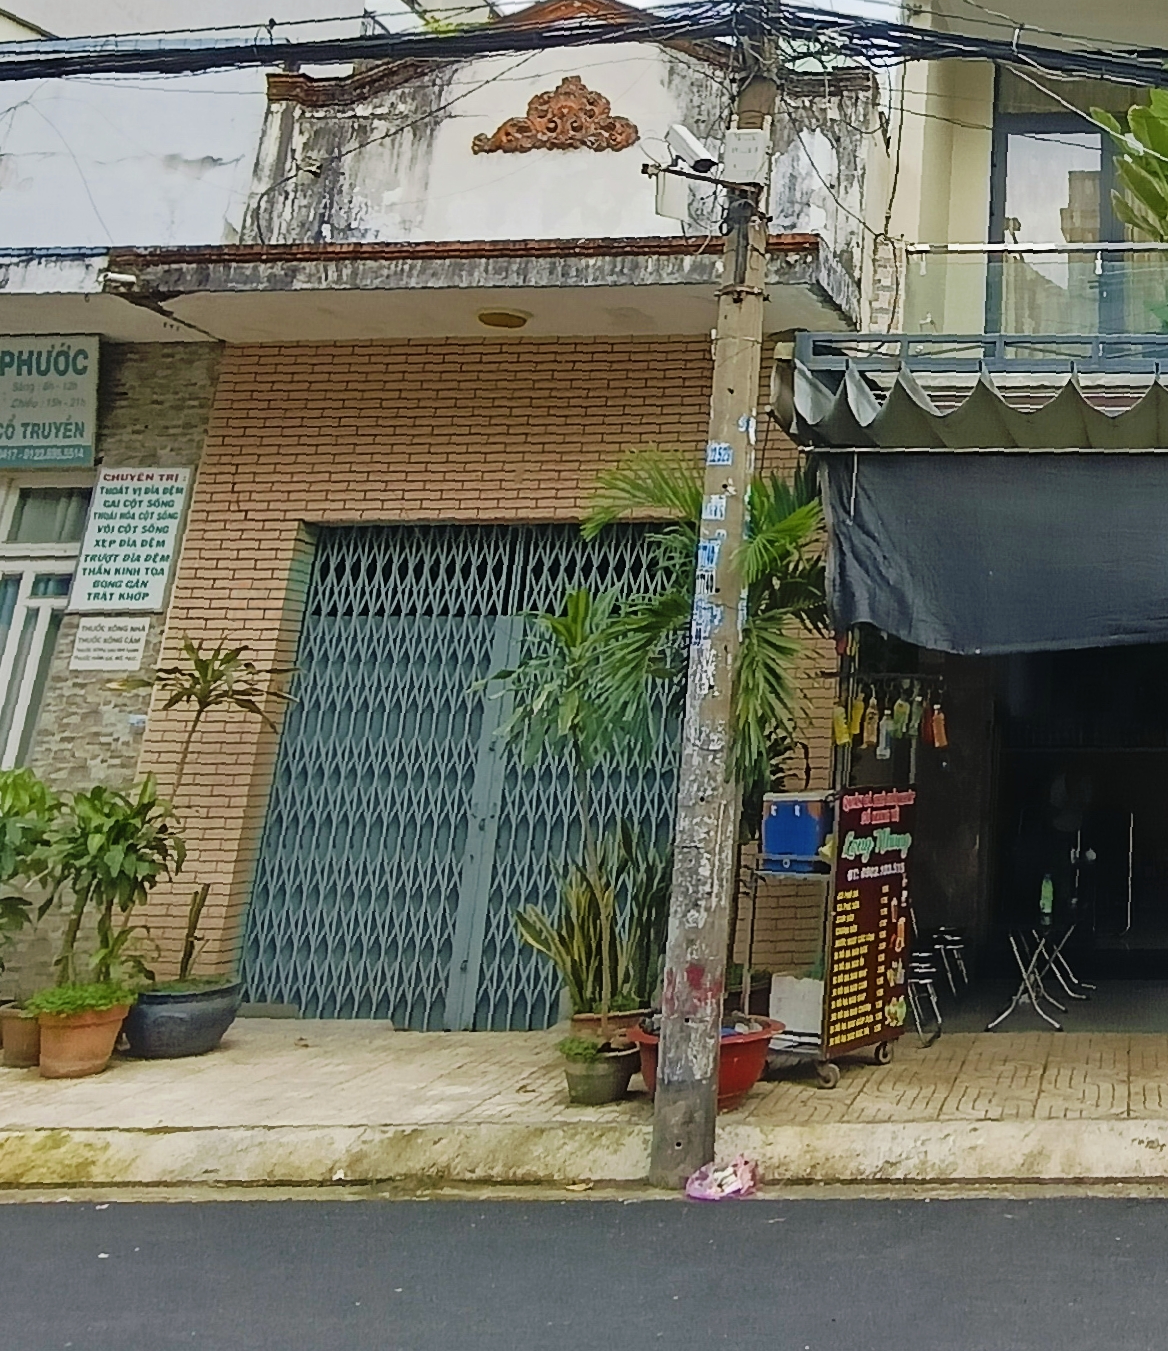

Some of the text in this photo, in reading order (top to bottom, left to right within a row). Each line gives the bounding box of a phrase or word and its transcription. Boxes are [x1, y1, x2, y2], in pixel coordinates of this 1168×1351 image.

[0, 342, 89, 377] PHƯỚC
[103, 472, 155, 482] CHUYÊN
[113, 567, 141, 576] KINH
